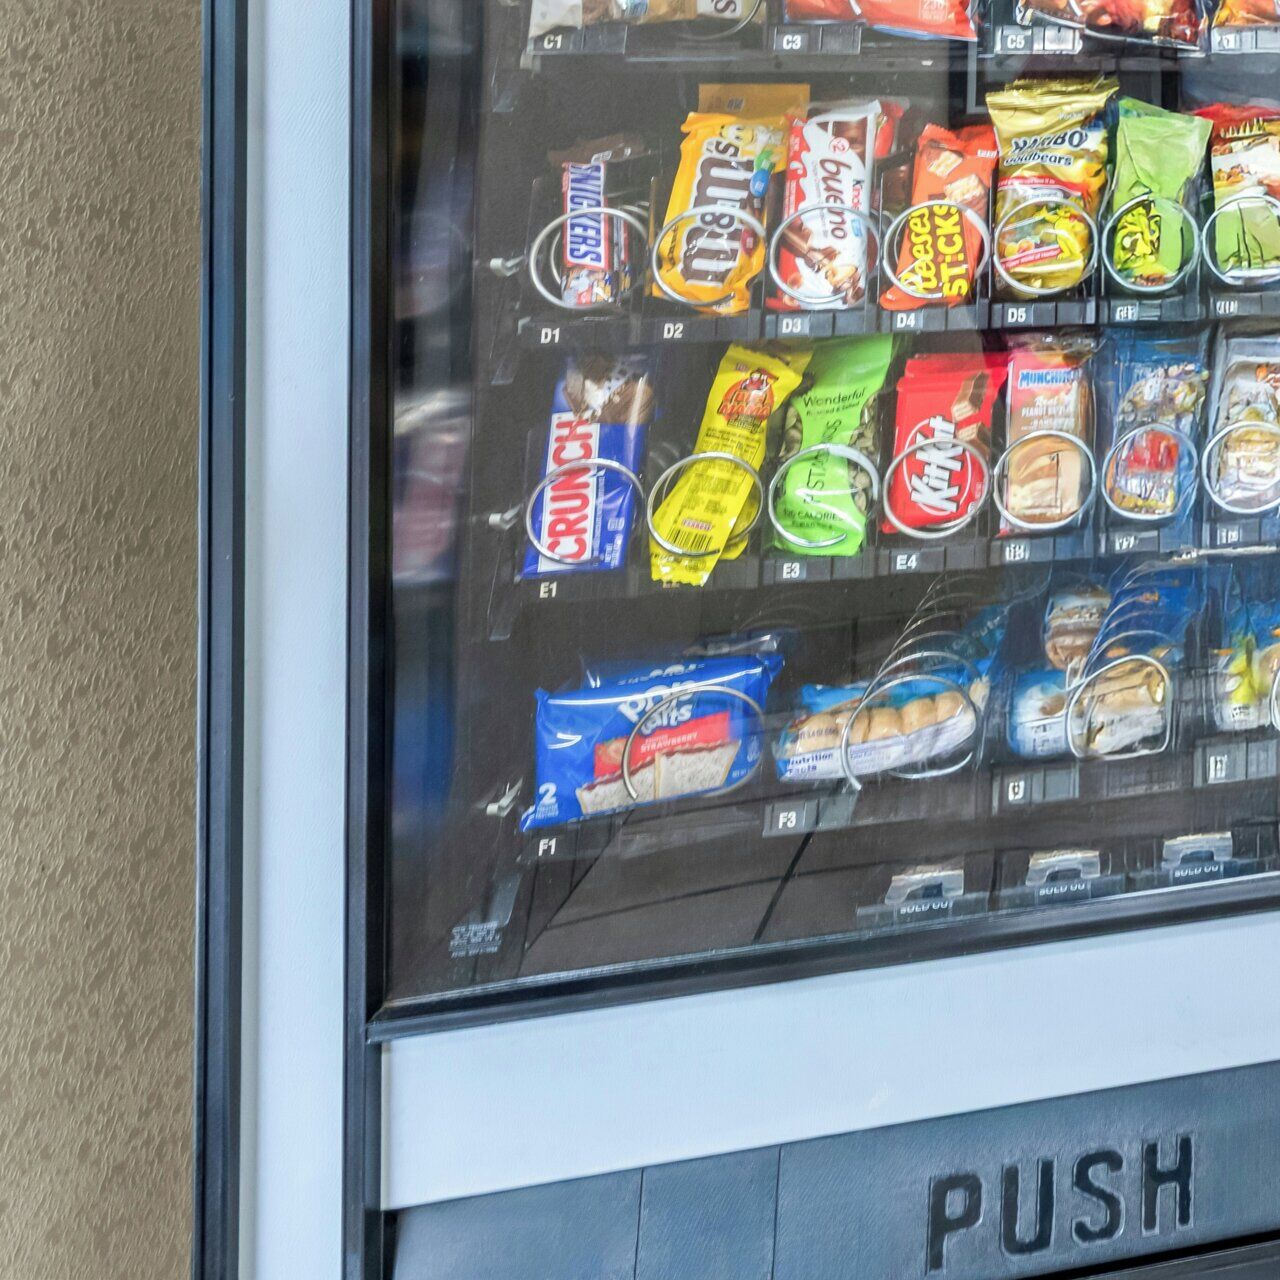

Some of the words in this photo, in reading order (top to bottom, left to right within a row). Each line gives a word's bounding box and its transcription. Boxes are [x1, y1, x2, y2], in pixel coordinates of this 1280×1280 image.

[543, 34, 564, 50] C1
[782, 34, 802, 50] C3
[1006, 34, 1026, 49] C5
[819, 157, 853, 240] bueno
[782, 319, 802, 334] D3
[896, 313, 916, 328] D4
[540, 327, 561, 344] D1
[663, 323, 684, 339] D2
[803, 386, 867, 408] Wonderful
[895, 554, 918, 570] E4
[782, 563, 801, 579] E3
[539, 582, 557, 599] E1
[640, 731, 699, 754] STRAWBERRY
[538, 782, 557, 805] 2
[778, 811, 797, 829] F3
[538, 838, 557, 857] F1
[926, 1131, 1195, 1276] PUSH
